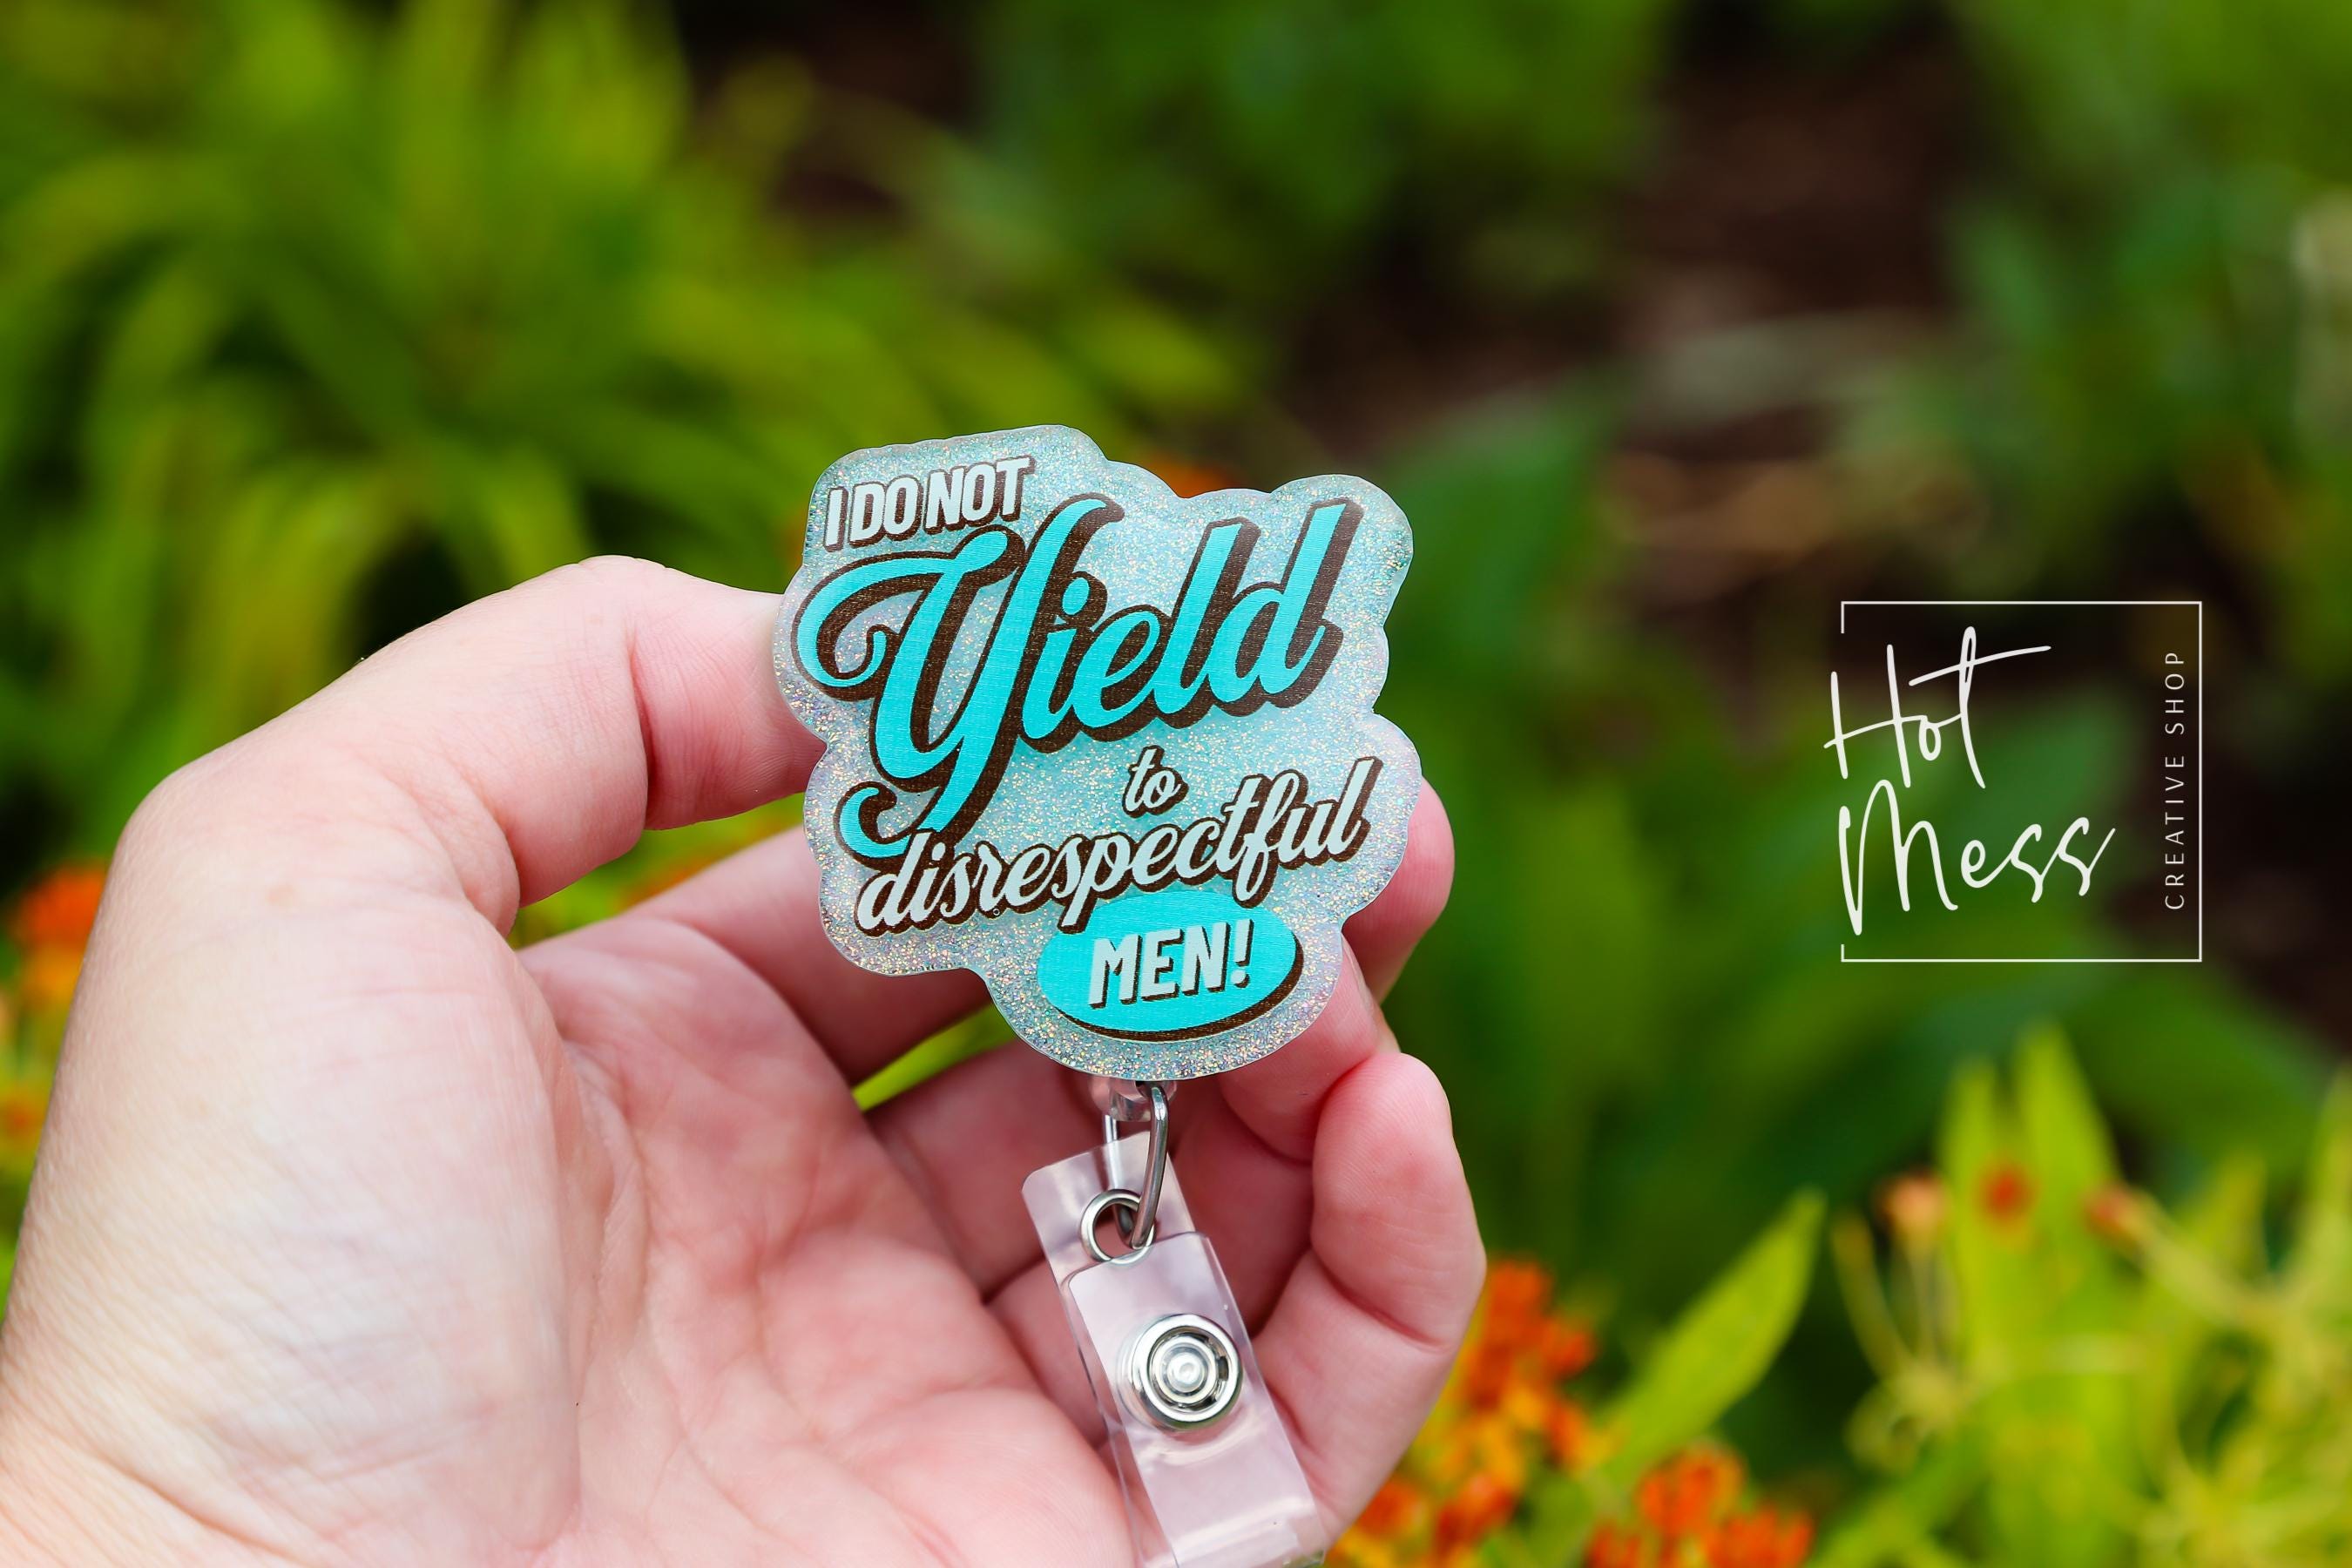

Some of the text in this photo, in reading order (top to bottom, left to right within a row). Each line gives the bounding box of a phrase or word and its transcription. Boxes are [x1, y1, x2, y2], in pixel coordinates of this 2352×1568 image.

[823, 456, 1035, 551] I DO NOT
[792, 494, 1363, 864] Yield
[1122, 746, 1188, 815] to
[855, 757, 1383, 936] disrespectful
[1088, 919, 1254, 1009] MEN!
